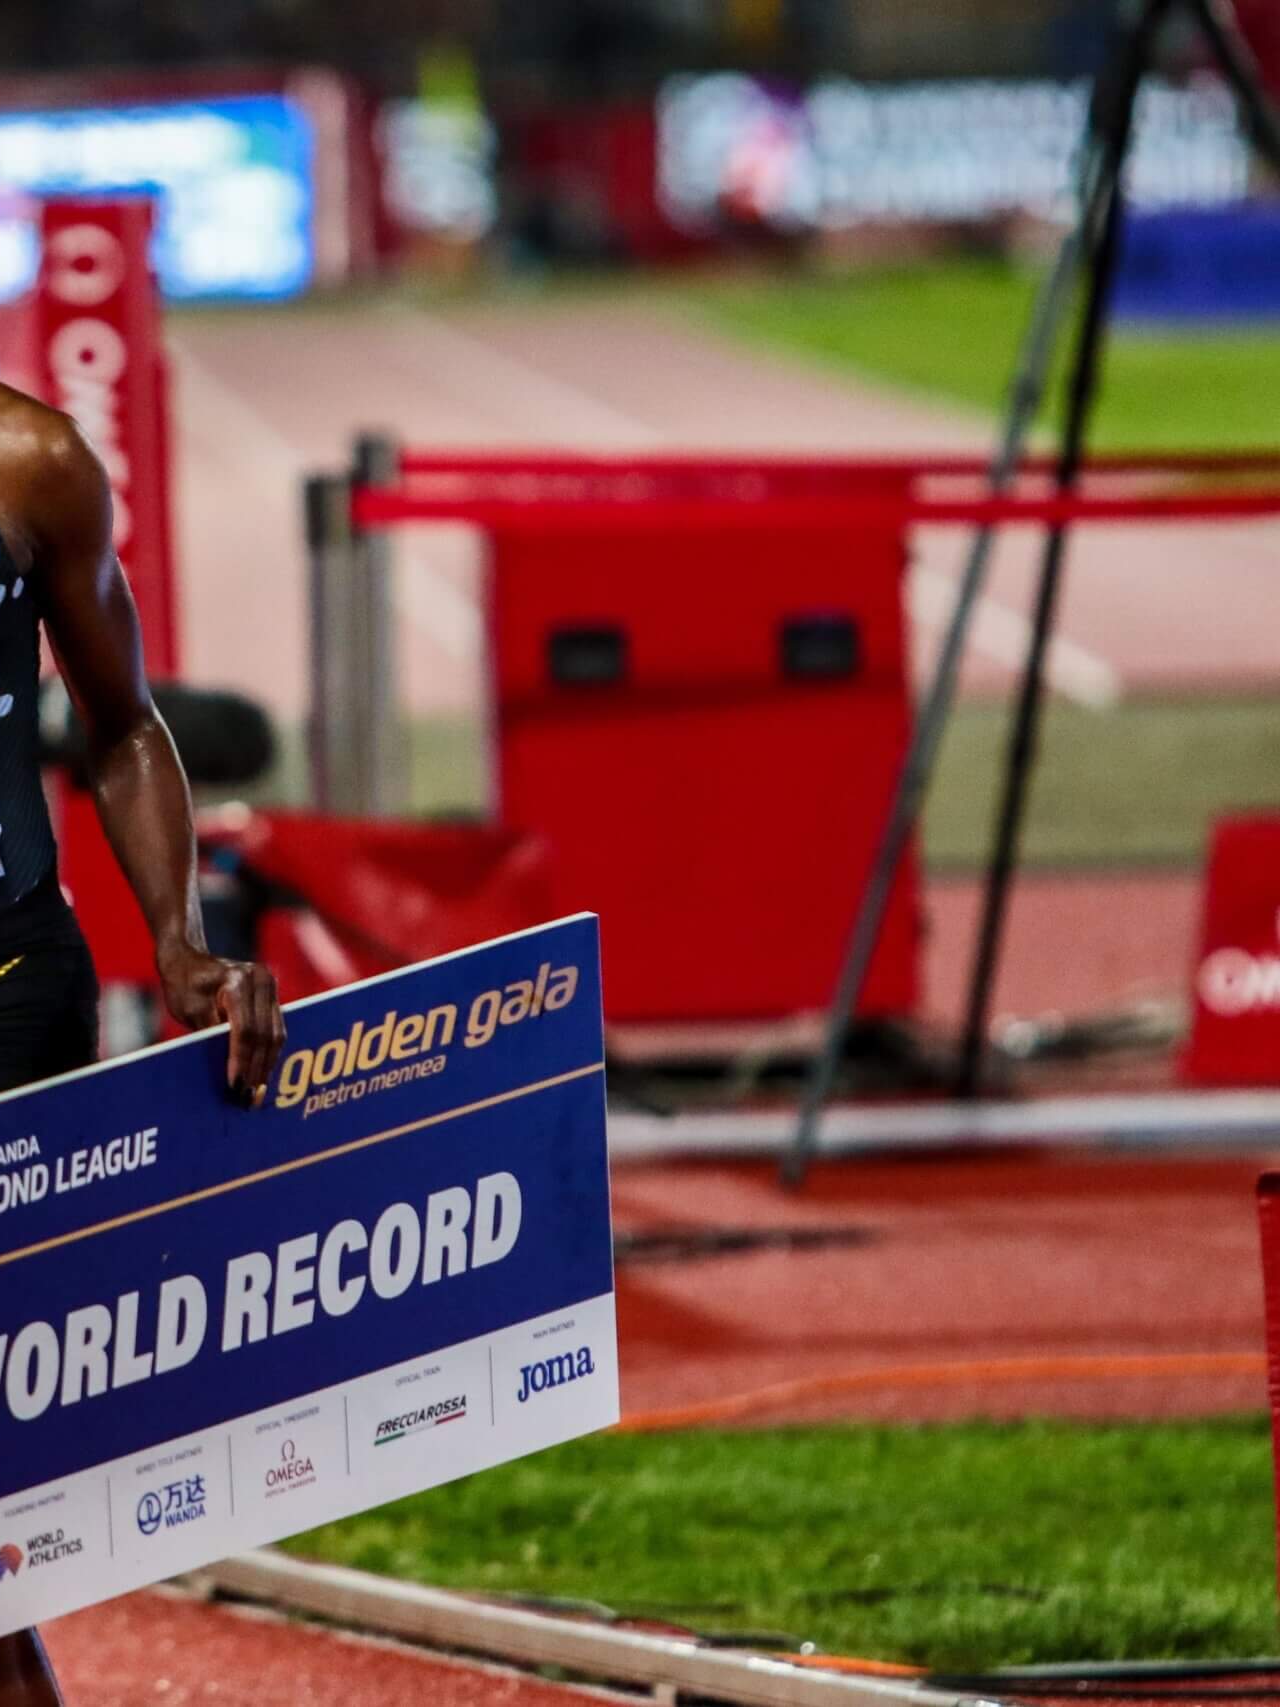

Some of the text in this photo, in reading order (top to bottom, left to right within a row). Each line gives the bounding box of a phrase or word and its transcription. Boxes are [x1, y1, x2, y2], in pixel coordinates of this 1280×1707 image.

[275, 961, 579, 1109] golden gala
[302, 1053, 447, 1120] pietro mennea
[54, 1127, 159, 1194] LEAGUE
[220, 1171, 522, 1353] RECORD
[375, 1393, 467, 1438] FRECCIAROSSA
[163, 1473, 206, 1512] 万达
[265, 1456, 314, 1487] OMEGA
[164, 1503, 206, 1528] WANDA
[27, 1527, 65, 1552] WORLD
[28, 1538, 83, 1569] ATHLETICS
